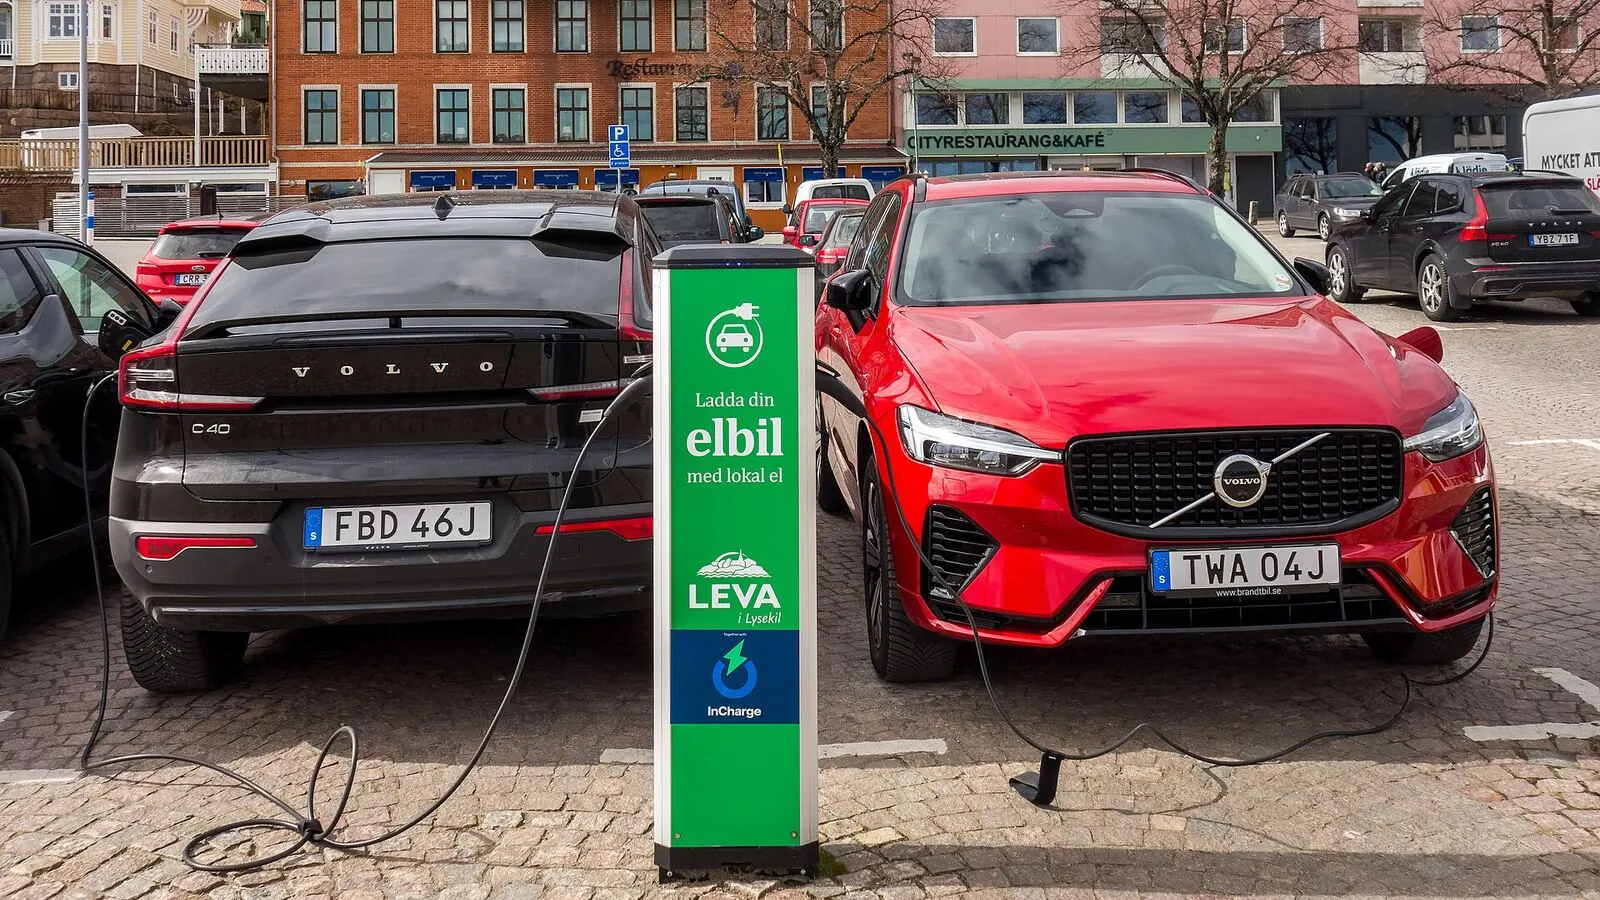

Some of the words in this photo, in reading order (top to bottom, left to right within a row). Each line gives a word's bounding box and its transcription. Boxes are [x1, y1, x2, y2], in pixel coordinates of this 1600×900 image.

[615, 127, 624, 140] P
[907, 132, 1105, 149] CITYRESTAURANG&KAFÉ
[1541, 153, 1580, 169] MYCKET
[1537, 234, 1555, 244] YBZ
[1558, 233, 1574, 243] 71F
[183, 275, 200, 283] CRR
[292, 361, 494, 378] VOLVO
[696, 392, 744, 408] Ladda
[749, 392, 774, 408] din
[192, 423, 231, 435] C40
[686, 418, 784, 457] elbil
[687, 468, 722, 483] med
[727, 468, 765, 483] lokal
[769, 468, 783, 483] el
[310, 531, 317, 541] S
[335, 510, 398, 541] FBD
[411, 506, 475, 538] 46J
[1158, 575, 1166, 584] S
[1182, 553, 1249, 585] TWA
[1260, 550, 1324, 582] 04J
[688, 583, 782, 609] LEVA
[1216, 587, 1282, 597] www.brandtbil.se
[737, 612, 742, 624] i
[745, 611, 782, 627] Lysekil
[707, 706, 762, 719] InCharge
